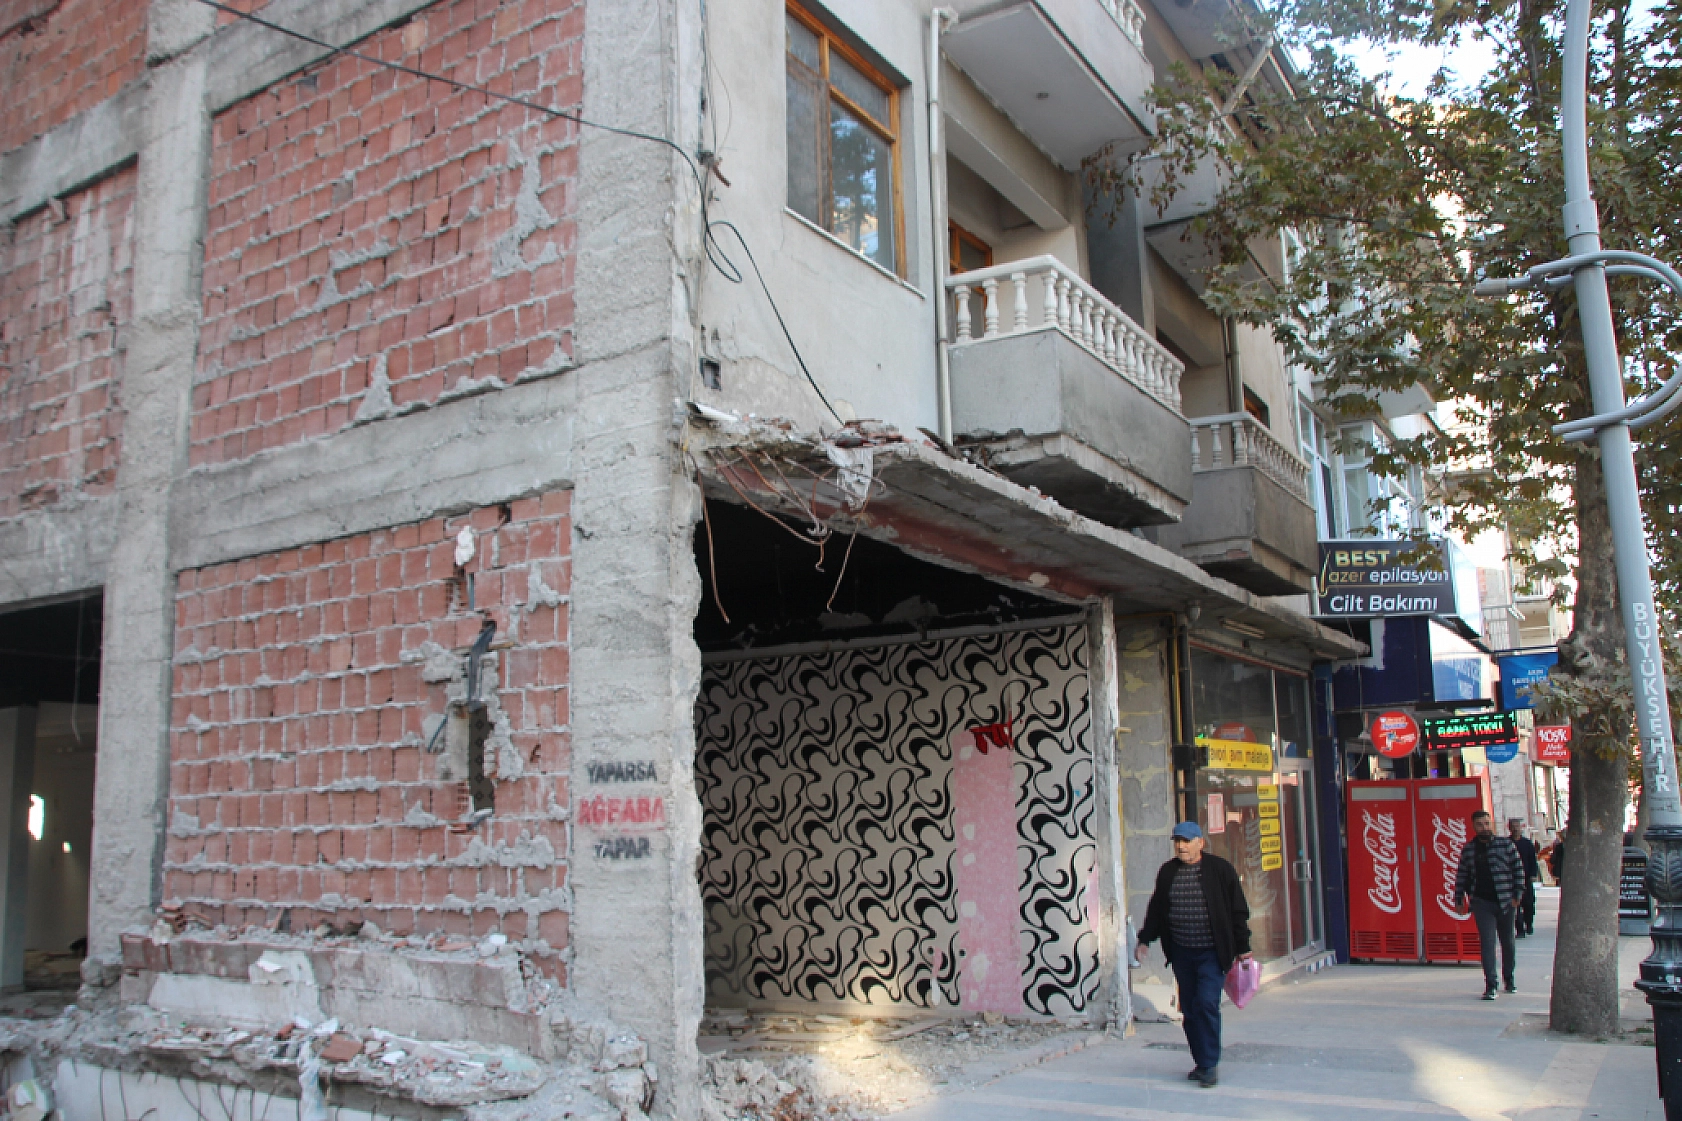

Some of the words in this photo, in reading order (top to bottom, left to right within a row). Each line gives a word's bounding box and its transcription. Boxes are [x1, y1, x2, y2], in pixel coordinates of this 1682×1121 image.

[1335, 550, 1390, 567] BEST
[1330, 595, 1363, 611] Cilt
[1369, 593, 1437, 611] Bakımı
[584, 760, 658, 784] YAPARSA
